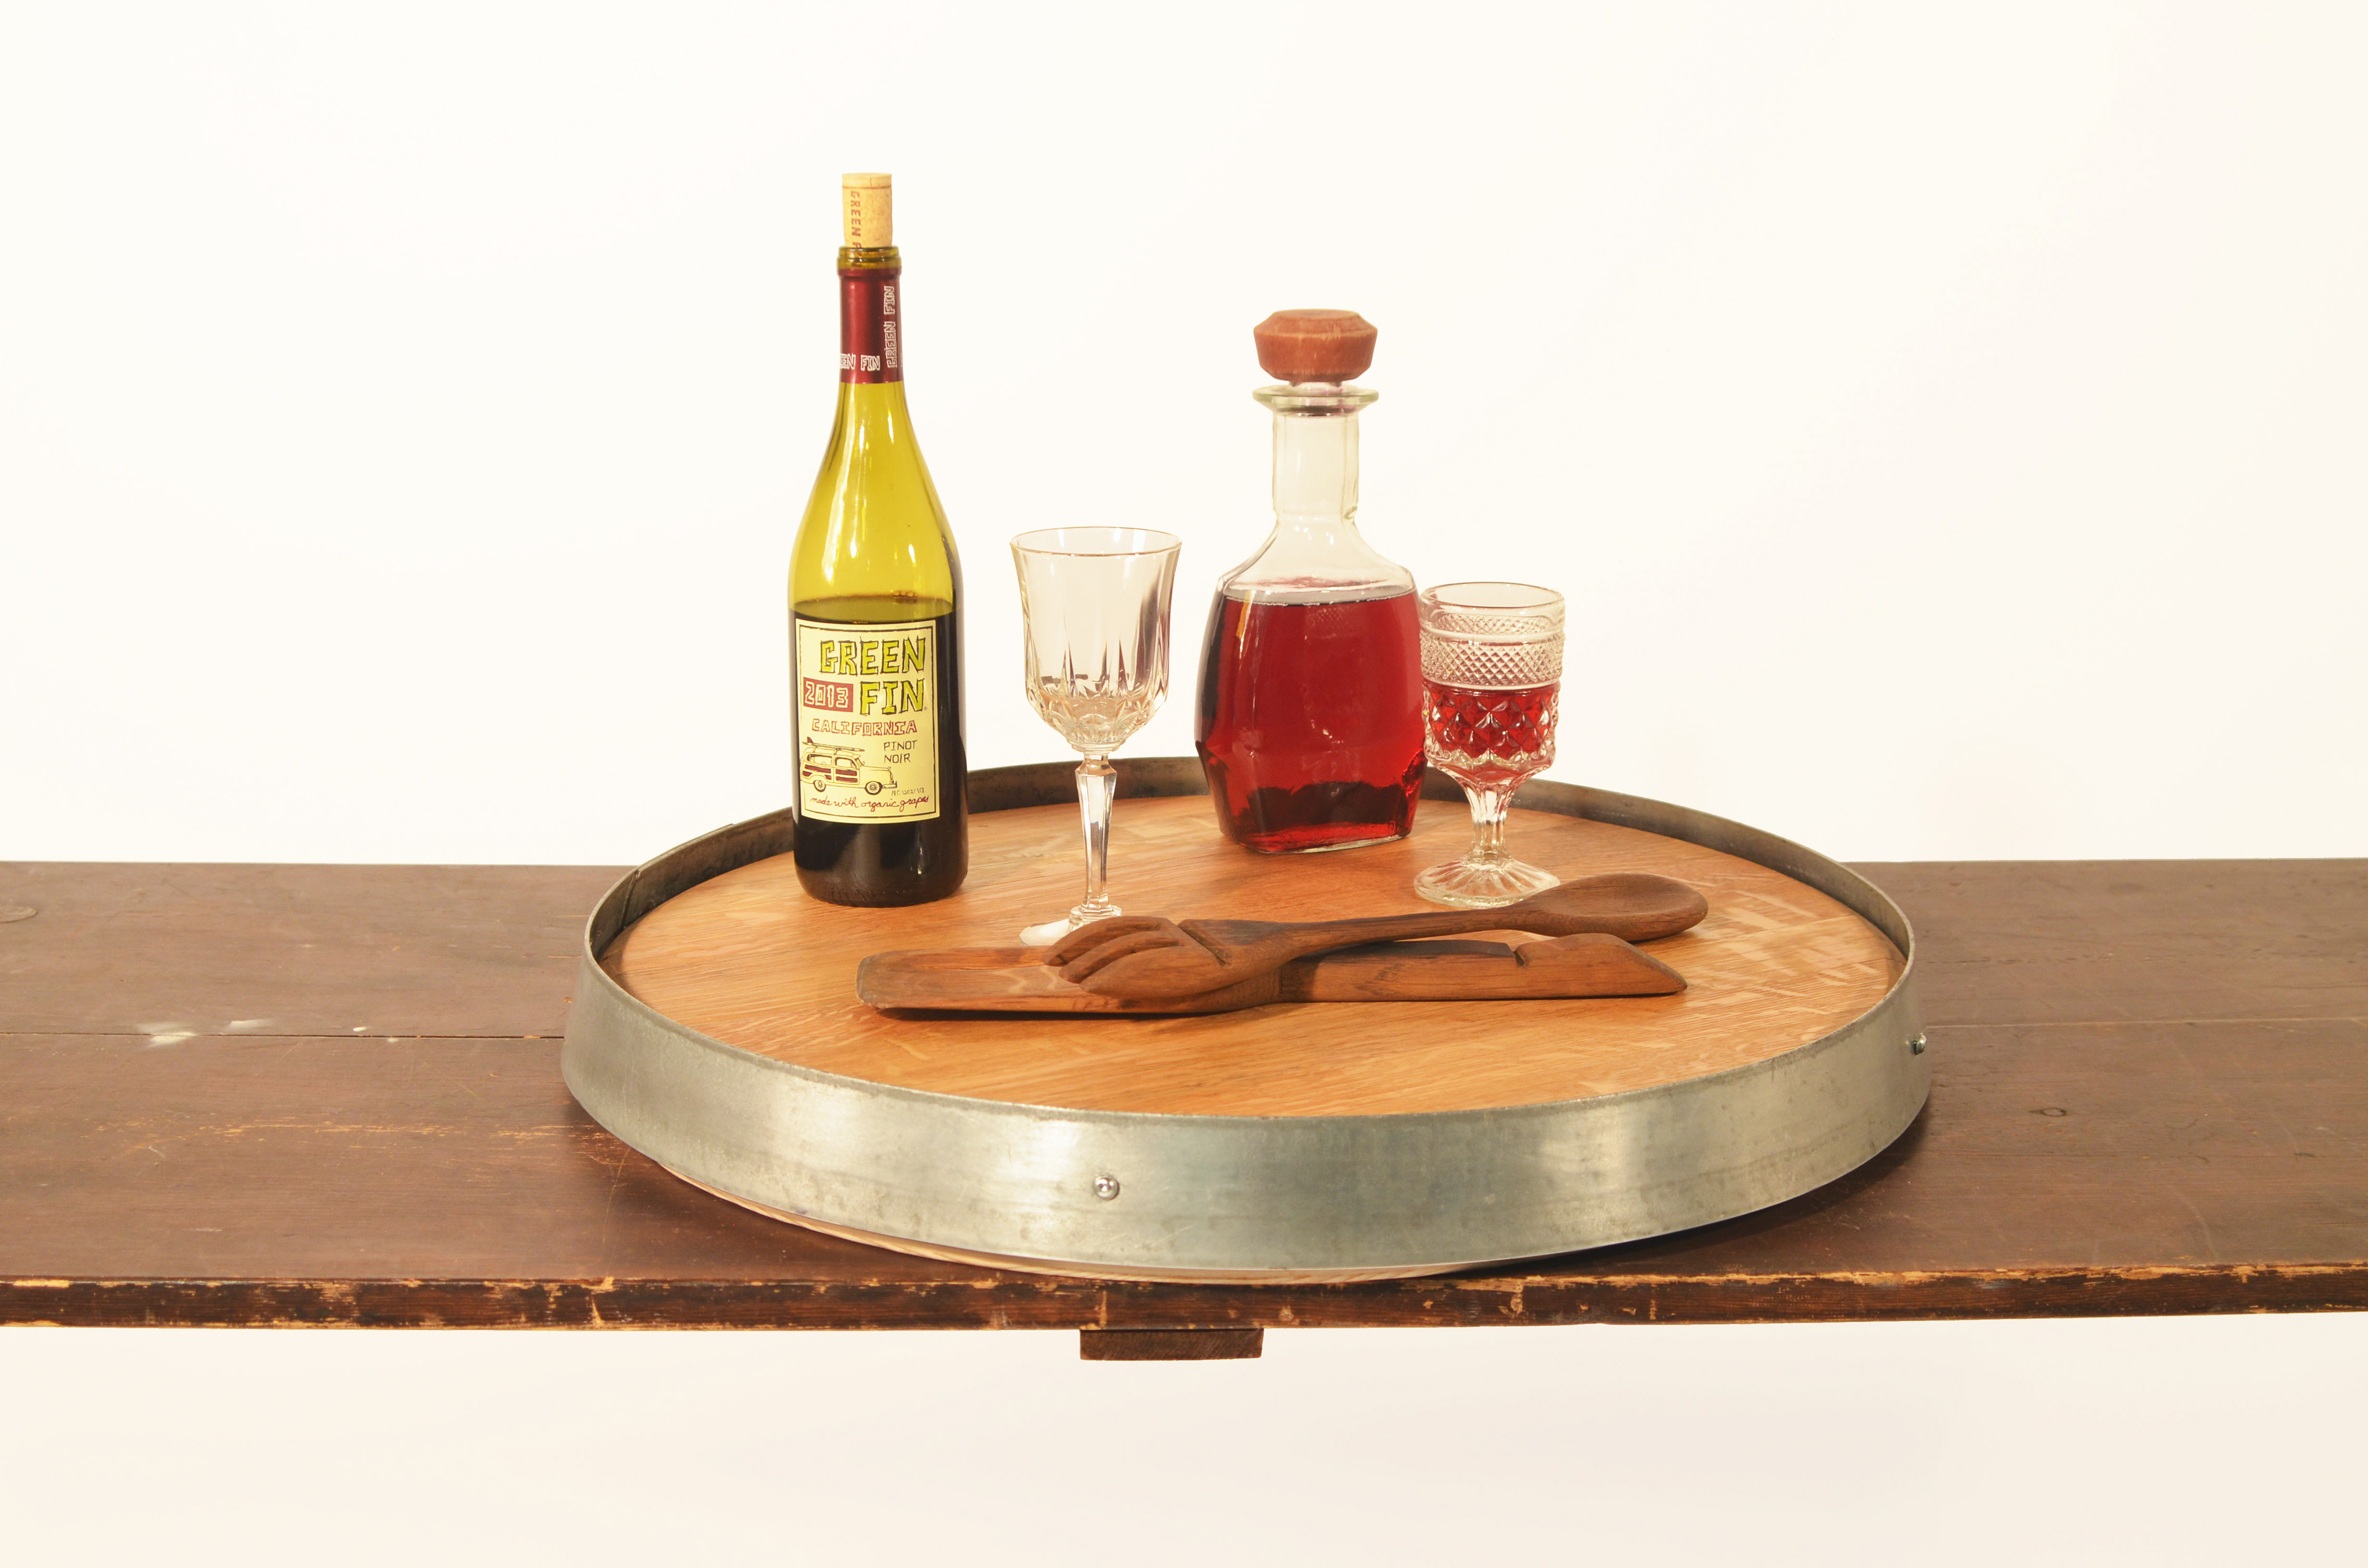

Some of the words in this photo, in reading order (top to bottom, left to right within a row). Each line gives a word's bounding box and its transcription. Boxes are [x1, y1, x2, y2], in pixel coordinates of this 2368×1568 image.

[850, 191, 861, 236] GREEN
[883, 285, 895, 315] FIN
[884, 321, 897, 368] GREEN
[860, 355, 880, 371] FIN
[820, 636, 926, 675] GREEN
[805, 681, 849, 708] 2013
[860, 678, 925, 716] FIN
[812, 718, 918, 736] CALIFORNIA
[884, 739, 918, 751] PINOT
[884, 753, 911, 763] NOIR
[810, 795, 832, 806] made
[834, 797, 859, 808] with
[861, 798, 900, 812] organic
[899, 795, 929, 812] grapes
